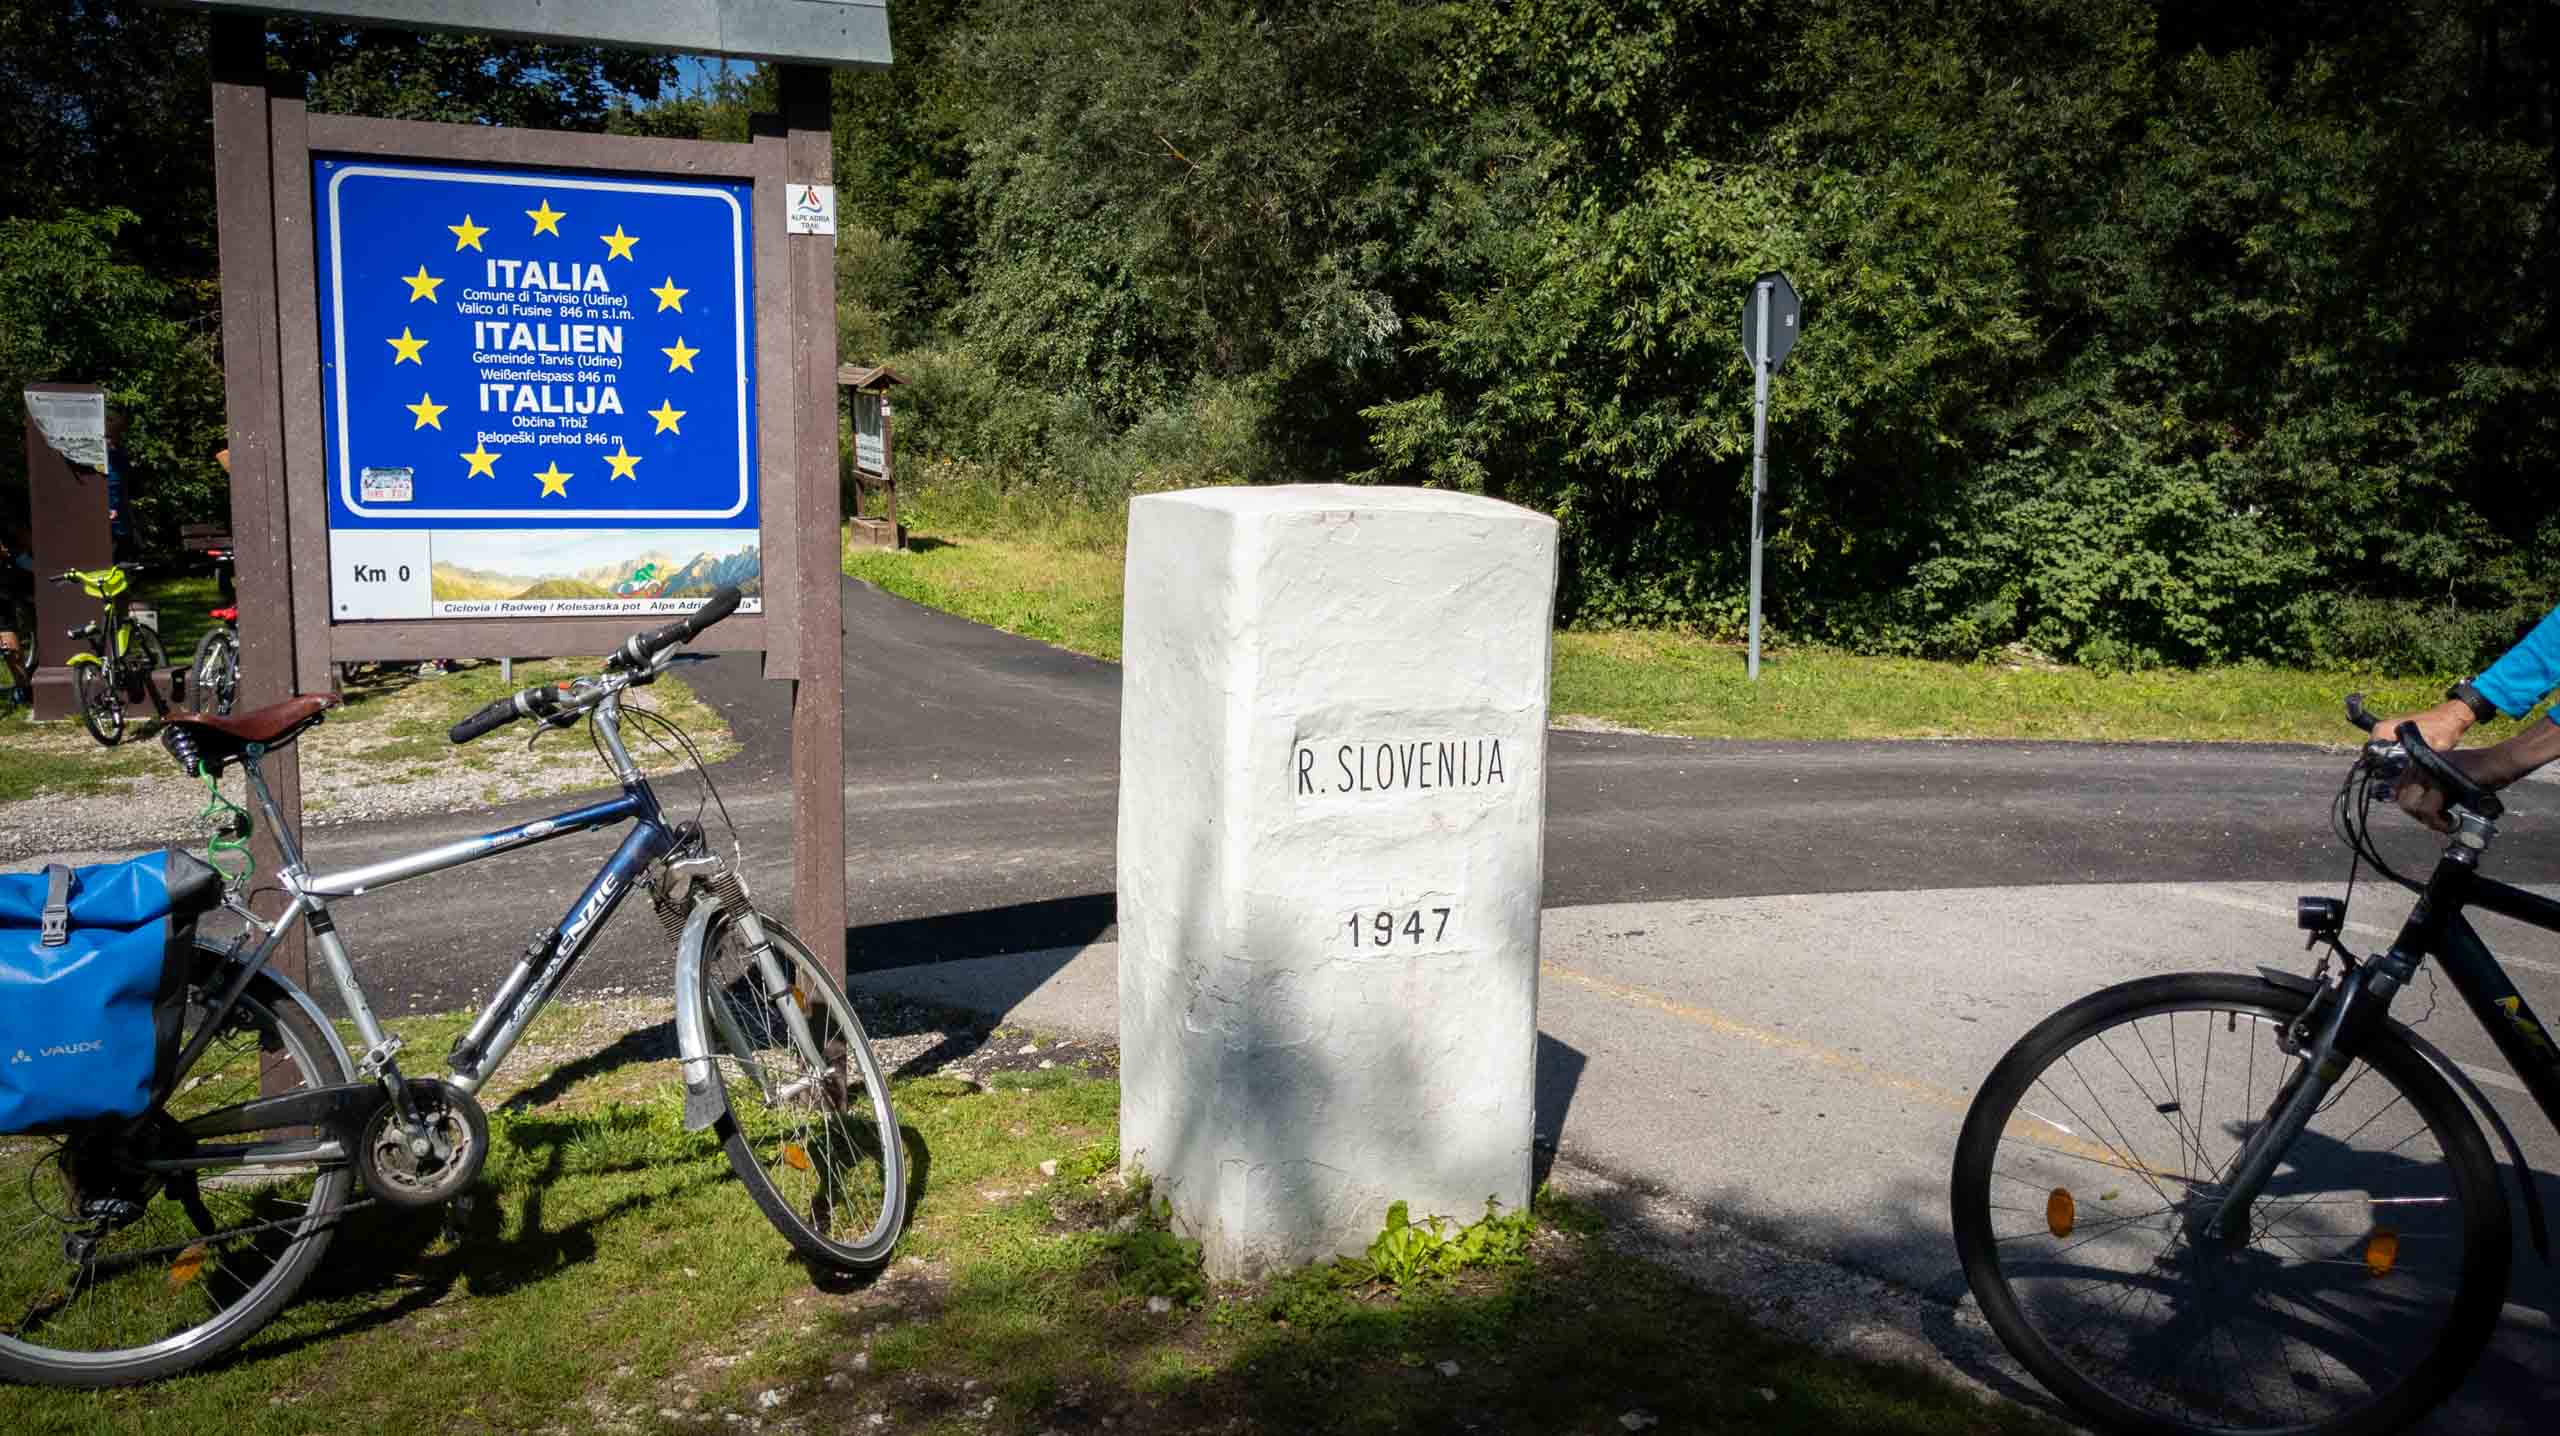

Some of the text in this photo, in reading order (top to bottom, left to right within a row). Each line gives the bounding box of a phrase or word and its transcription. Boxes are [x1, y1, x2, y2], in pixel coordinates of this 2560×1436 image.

[487, 259, 609, 292] ITALIA
[463, 288, 628, 308] Comune di Tarvisio (Udine)
[457, 302, 635, 320] Valico di Fusine 846 m s.l.m.
[474, 321, 623, 353] ITALIEN
[472, 352, 623, 369] Gemeinde Tarvis (Udine)
[480, 368, 616, 383] Weißenfelspass 846 m
[480, 383, 624, 414] ITALIJA
[512, 416, 588, 428] Občina Trbiž
[477, 431, 623, 445] Belopeški prehod 846 m
[354, 564, 410, 582] Km 0
[444, 603, 490, 612] Ciclovia
[501, 602, 547, 612] Radweg
[557, 602, 619, 611] Kolesarska
[622, 602, 641, 611] pot
[650, 601, 674, 611] Alpe
[1298, 739, 1504, 795] R. SLOVENIJA
[1348, 907, 1451, 947] 1947
